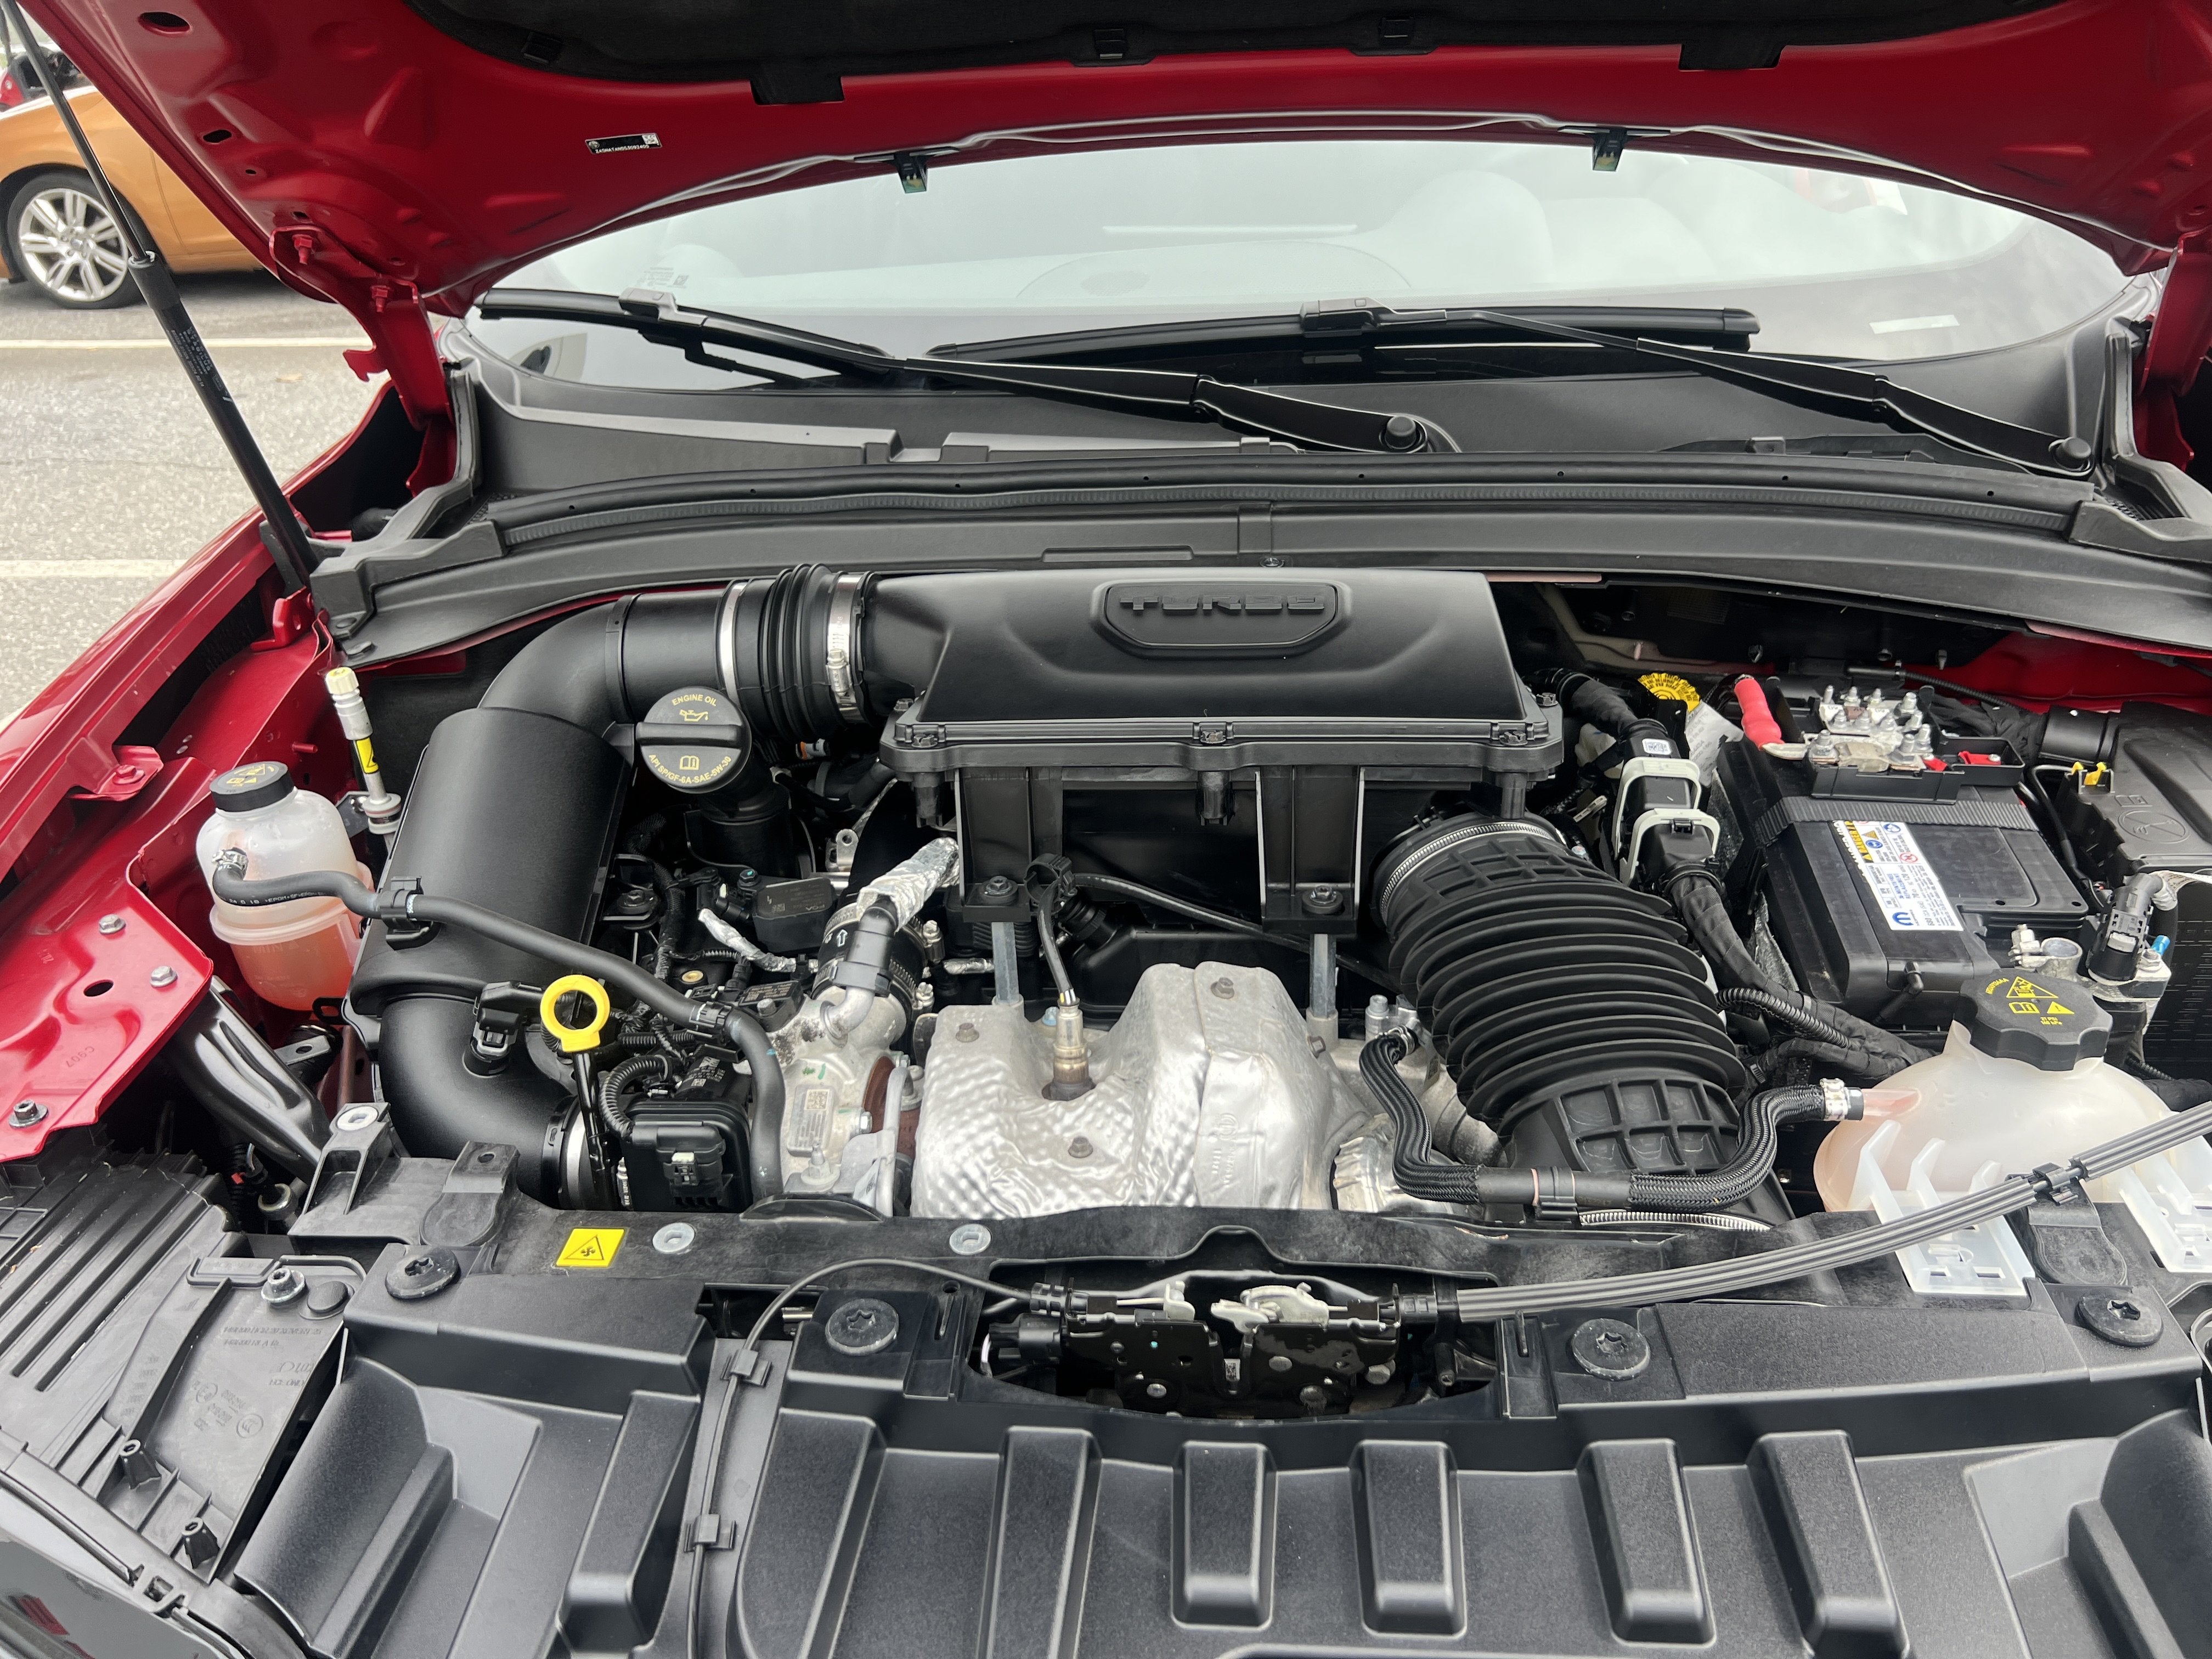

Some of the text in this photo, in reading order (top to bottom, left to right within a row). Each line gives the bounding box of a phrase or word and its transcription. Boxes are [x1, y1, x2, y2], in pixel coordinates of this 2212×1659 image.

[672, 694, 717, 707] ENGINE OIL
[648, 754, 732, 785] API SP/GF-6A-SAE-5W-30
[1848, 830, 1868, 853] DANGER
